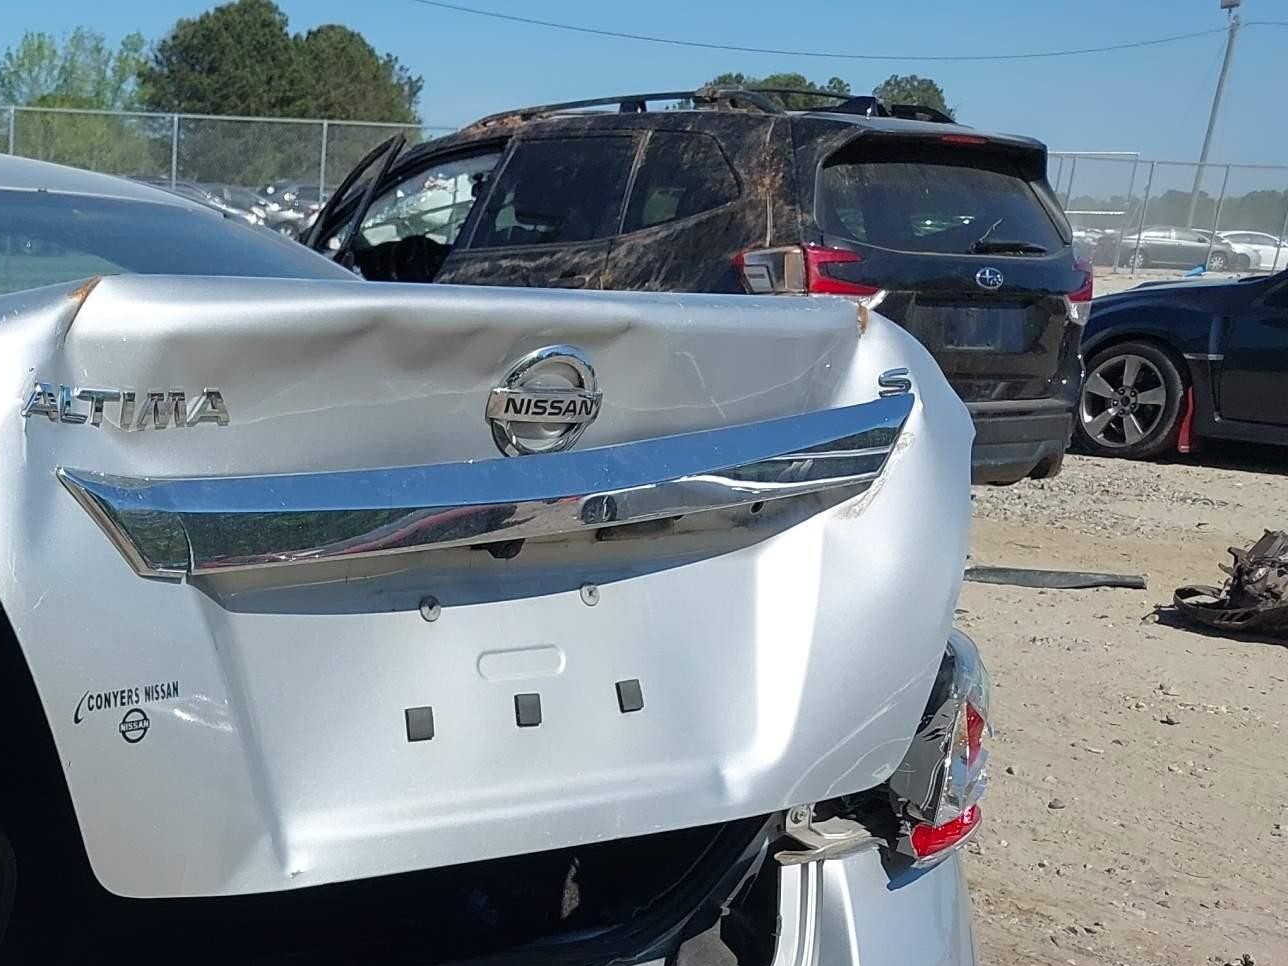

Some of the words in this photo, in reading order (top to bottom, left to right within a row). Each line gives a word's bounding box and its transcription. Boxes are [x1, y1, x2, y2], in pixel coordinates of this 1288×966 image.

[878, 367, 912, 398] S
[21, 381, 231, 432] ALTIMA
[503, 397, 594, 416] NISSAN
[87, 687, 140, 712] CONYERS
[144, 680, 179, 703] NISSAN
[120, 720, 150, 733] NISSAN
